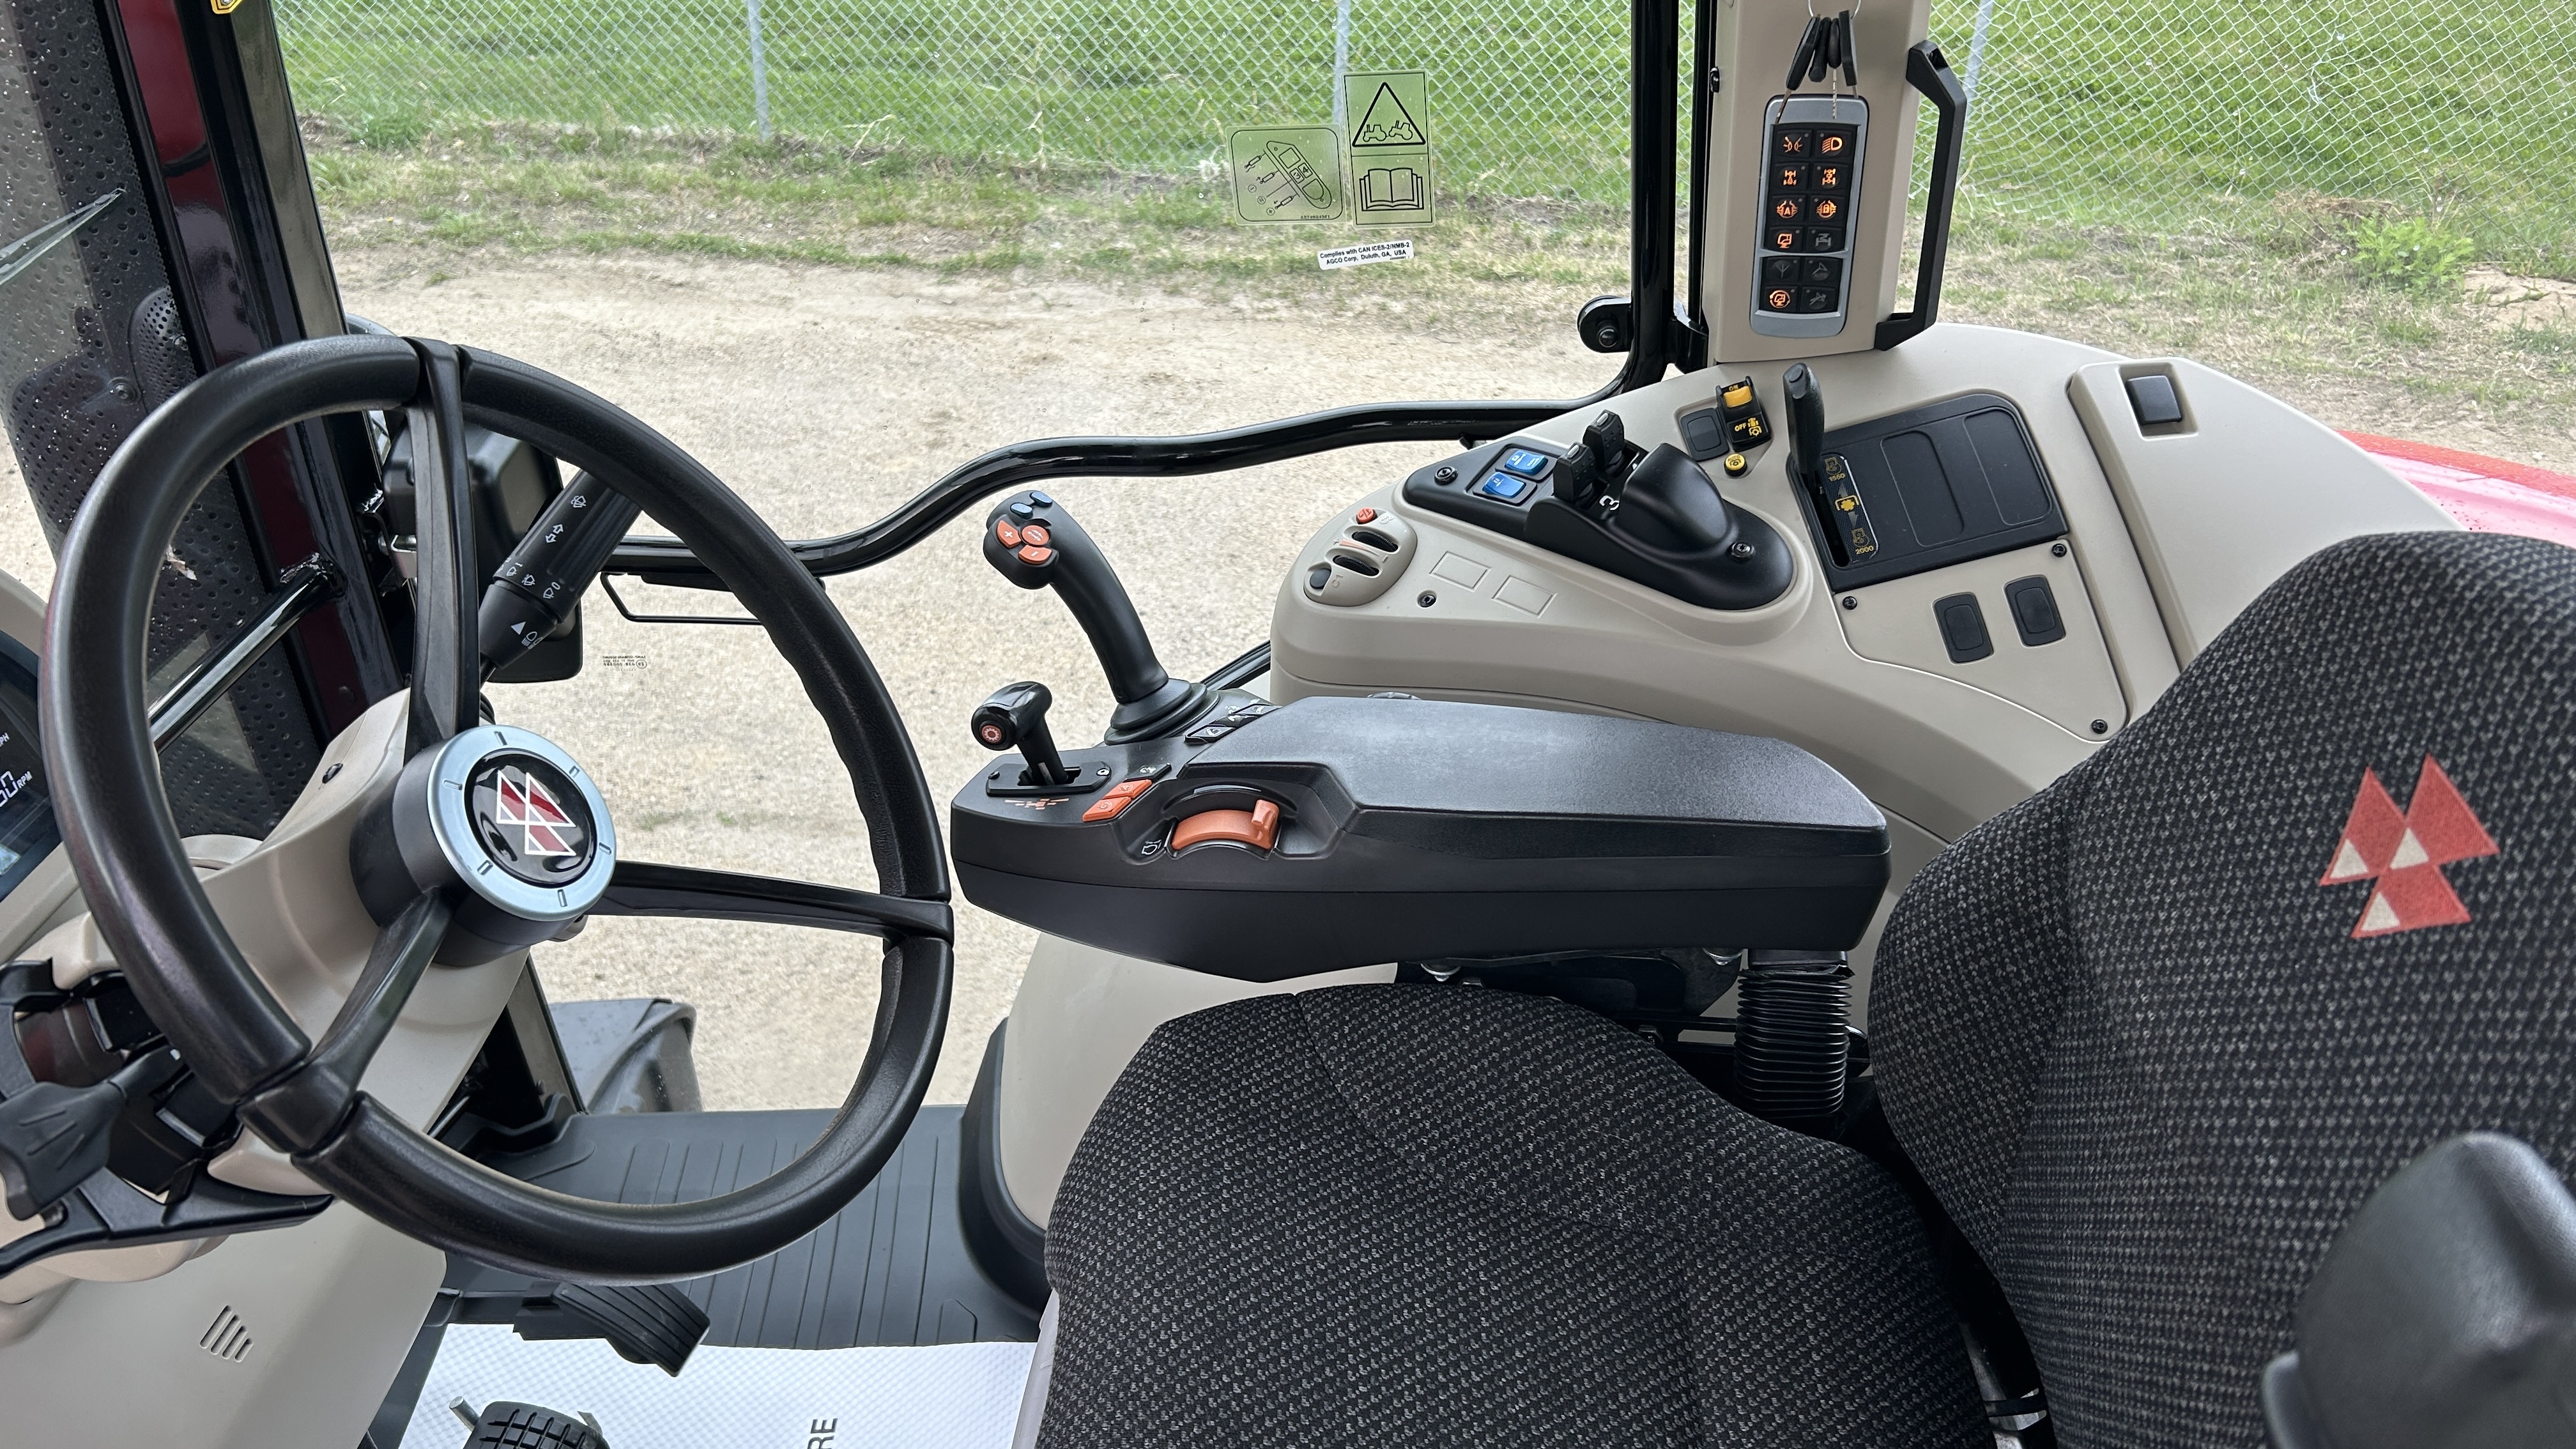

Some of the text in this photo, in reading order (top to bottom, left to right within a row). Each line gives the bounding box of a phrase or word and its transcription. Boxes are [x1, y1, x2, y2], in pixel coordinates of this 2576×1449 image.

[1293, 171, 1301, 180] 3
[1320, 250, 1345, 259] Complies
[1326, 257, 1343, 265] AGCO
[1735, 422, 1747, 432] OFF
[1855, 546, 1874, 555] 2000
[0, 732, 10, 747] PH
[17, 770, 33, 789] RPM
